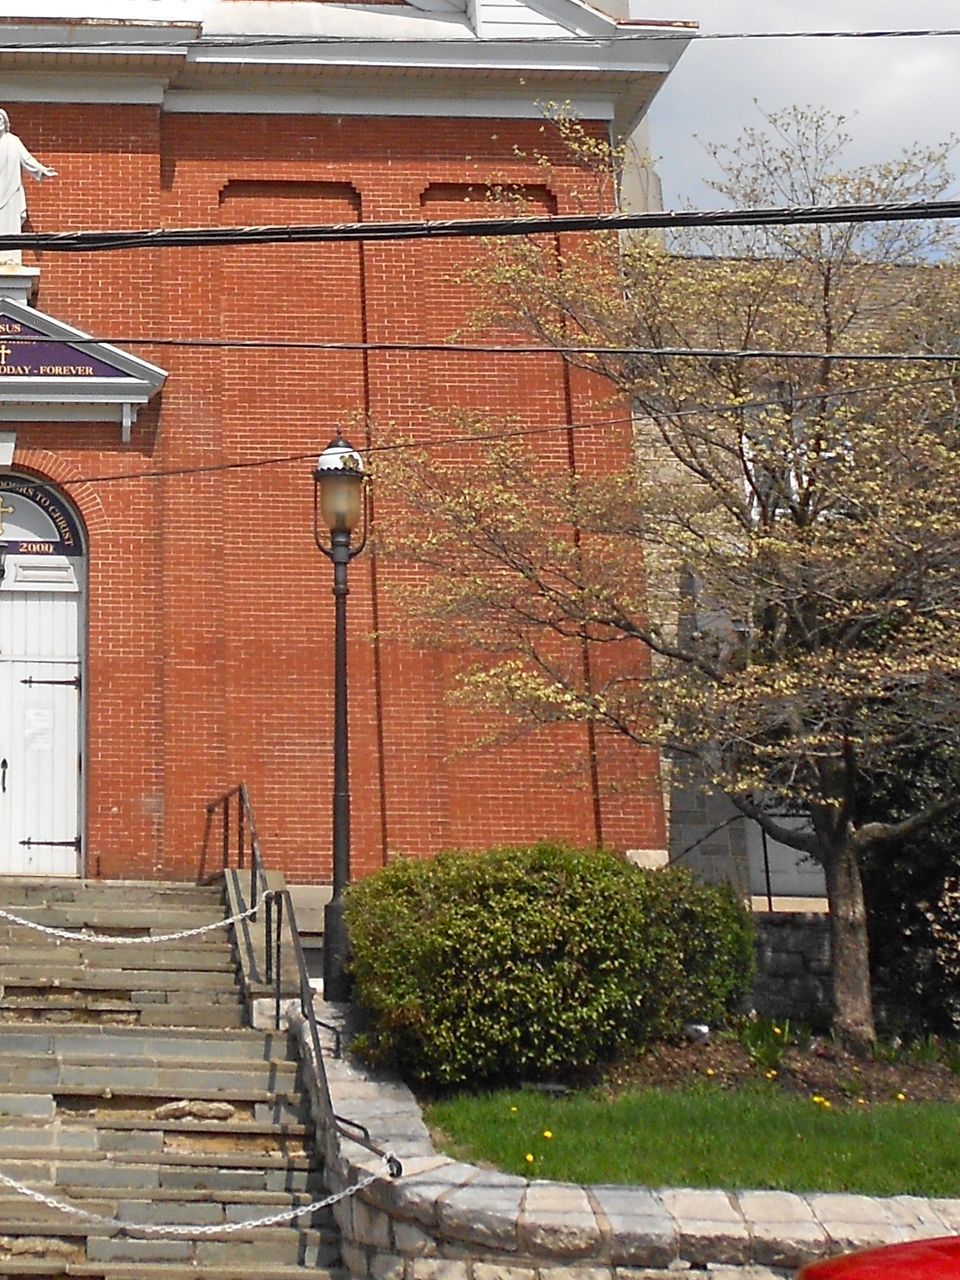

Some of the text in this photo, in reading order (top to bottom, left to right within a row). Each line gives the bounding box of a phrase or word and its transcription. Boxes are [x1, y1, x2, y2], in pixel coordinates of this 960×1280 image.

[39, 366, 93, 376] FOREVER
[35, 491, 50, 507] TO
[48, 507, 74, 546] CHRIST
[18, 542, 54, 553] 2000
